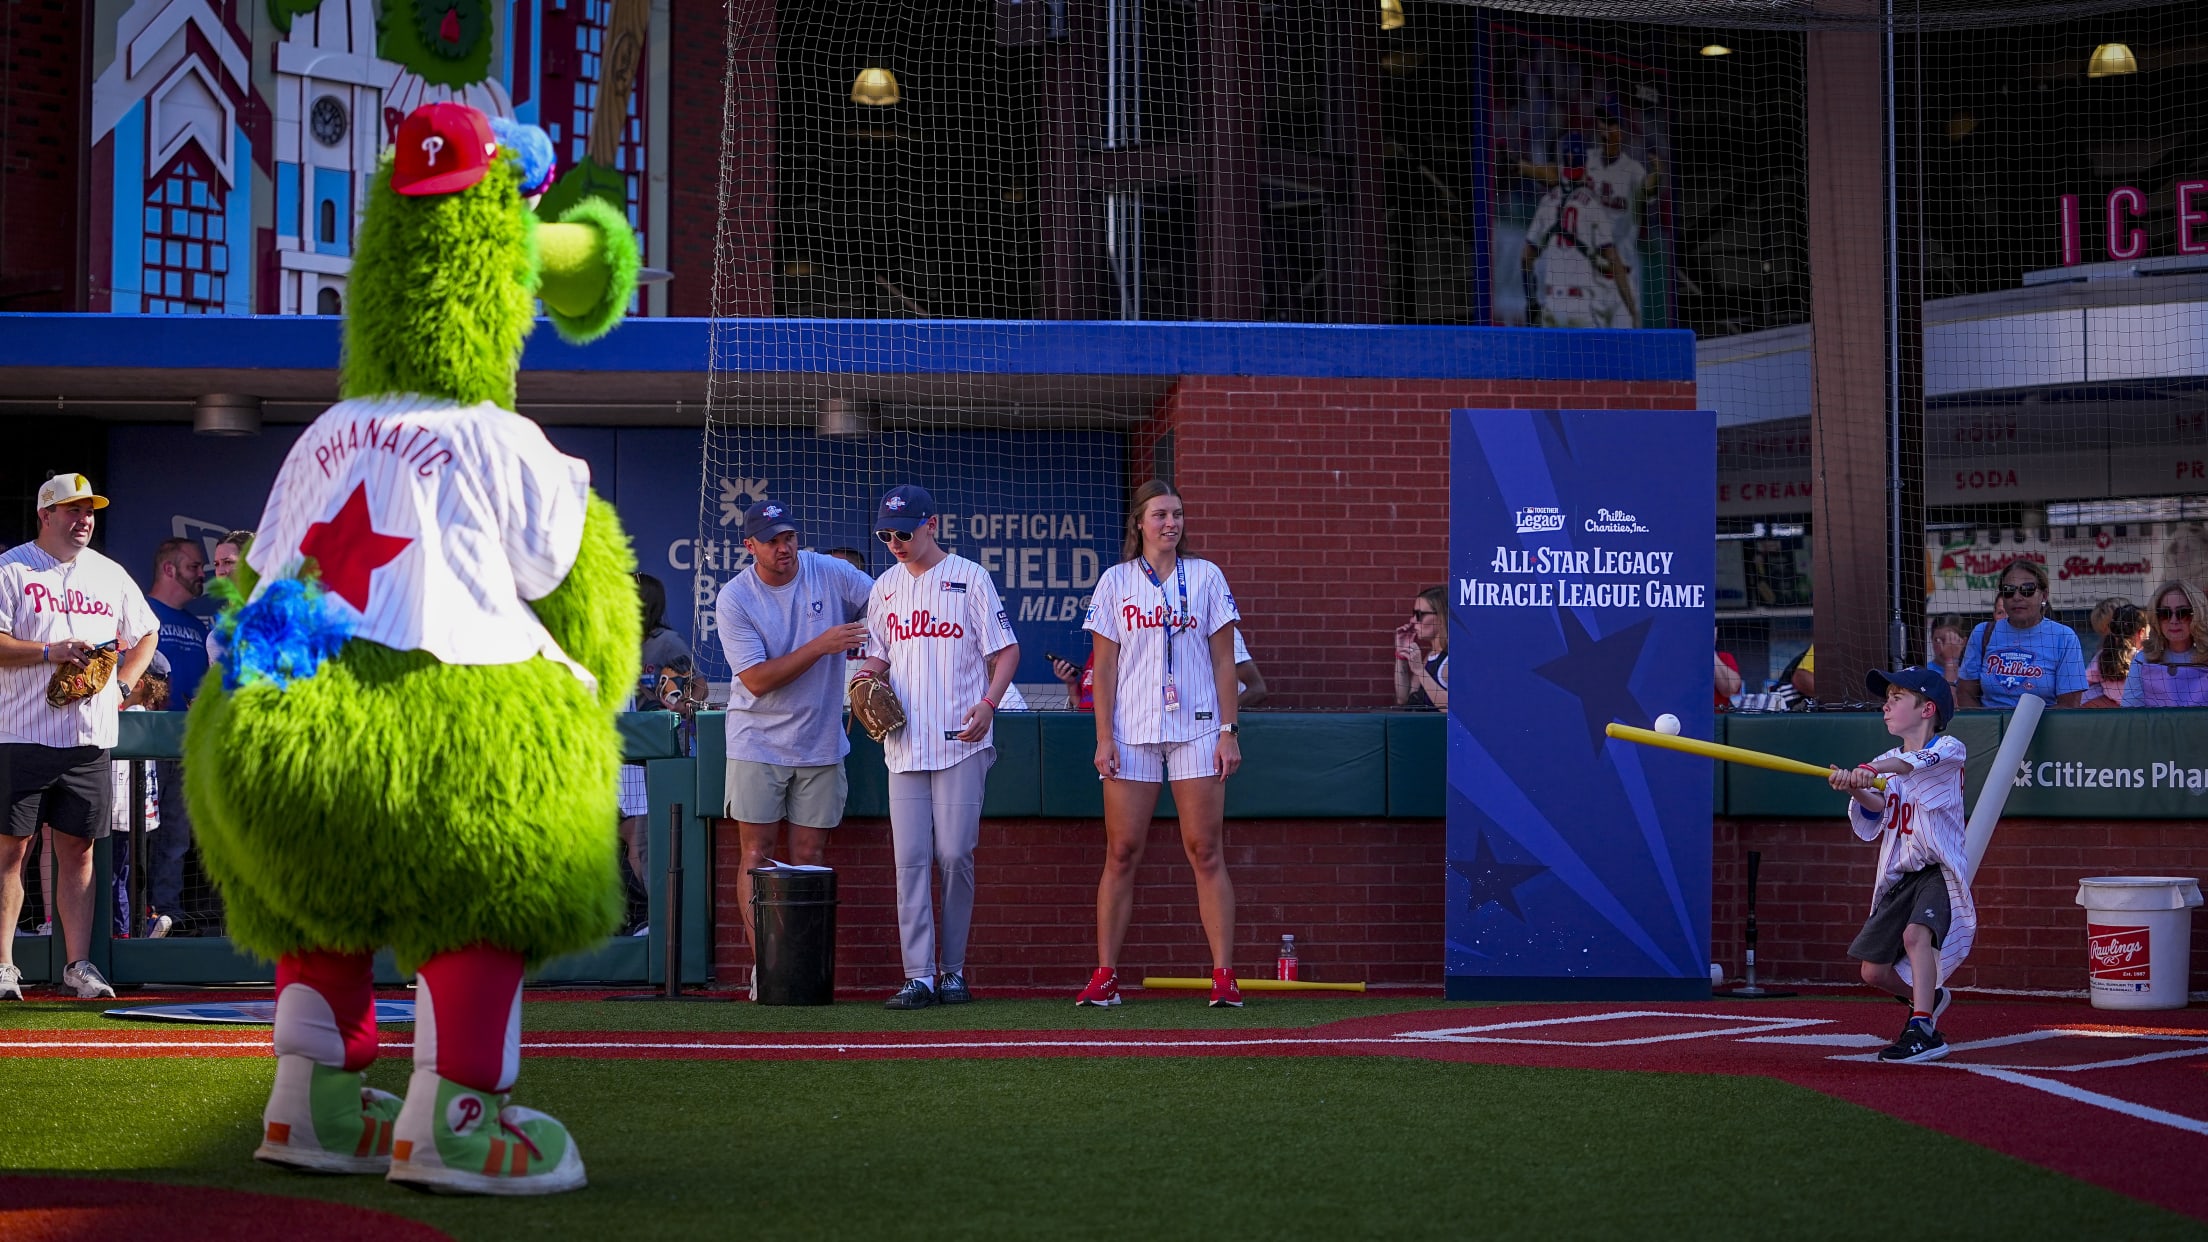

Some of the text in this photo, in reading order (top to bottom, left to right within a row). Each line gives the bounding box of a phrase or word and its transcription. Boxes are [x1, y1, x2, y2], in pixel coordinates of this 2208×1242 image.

[421, 136, 444, 166] P
[2060, 180, 2208, 267] ICE
[315, 417, 453, 479] PHANATIC
[1741, 480, 1812, 502] CREAM
[1956, 469, 2018, 490] SODA
[970, 513, 1094, 540] OFFICIAL
[1515, 511, 1566, 531] Legacy
[1597, 508, 1636, 522] Phillies
[980, 547, 1099, 589] FIELD
[1593, 547, 1674, 574] LEGACY
[24, 582, 114, 618] Phillies
[1459, 579, 1553, 607] MIRACLE
[1558, 580, 1640, 607] LEAGUE
[1645, 580, 1705, 607] GAME
[887, 609, 964, 645] Phillies
[1987, 655, 2043, 678] Phillies
[2037, 761, 2145, 788] Citizens
[2090, 938, 2143, 962] Rawlings
[457, 1096, 482, 1132] P
